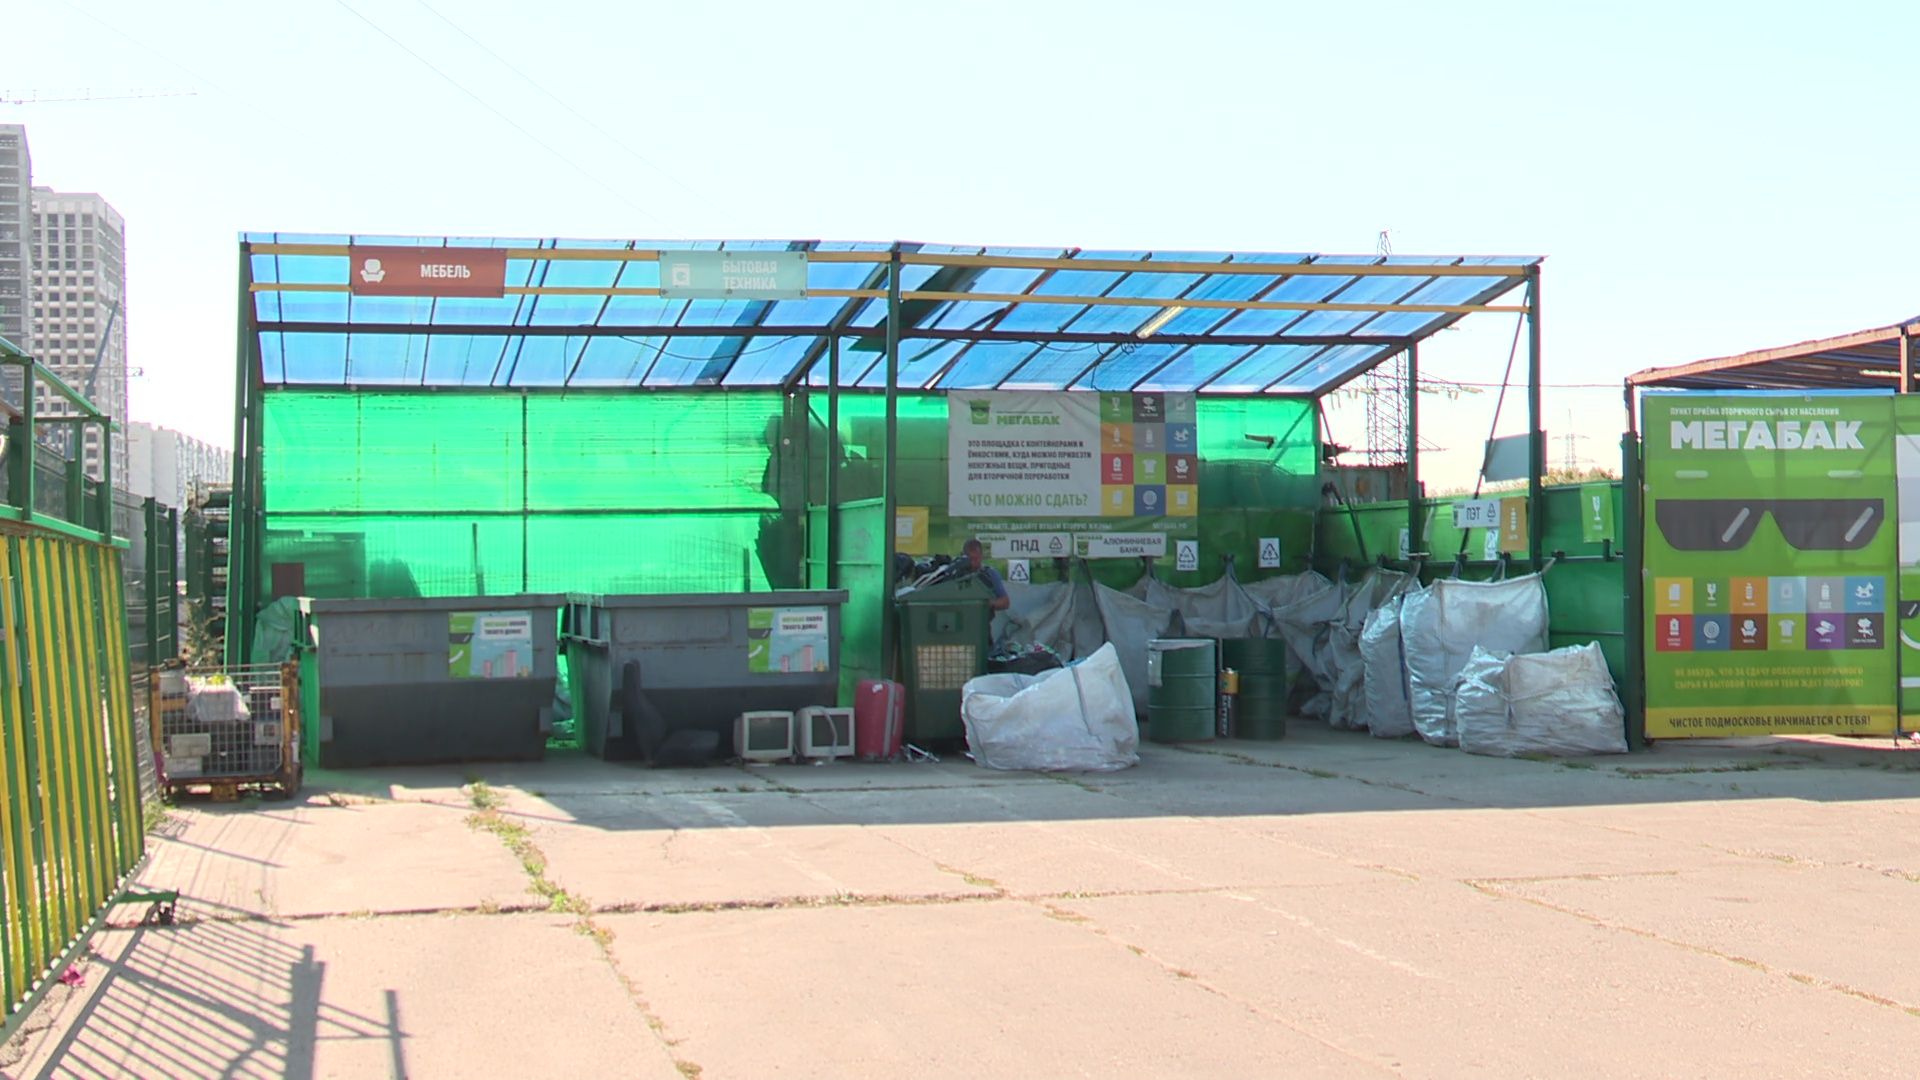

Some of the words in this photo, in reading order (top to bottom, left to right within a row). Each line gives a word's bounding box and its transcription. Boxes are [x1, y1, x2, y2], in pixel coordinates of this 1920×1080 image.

[420, 264, 471, 279] МЕБЕЛЬ
[722, 260, 777, 274] БЫТОВАЯ
[723, 276, 777, 290] ТЕХНИКА
[1670, 407, 1692, 416] ПУНКТ
[1693, 405, 1720, 416] ПРИЁМА
[1720, 407, 1764, 416] ВТОРИЧНОГО
[1765, 407, 1788, 416] СЫРЬЯ
[1789, 407, 1798, 416] ОТ
[1799, 407, 1839, 416] НАСЕЛЕНИЯ
[996, 415, 1060, 426] МЕГАБАК
[1670, 420, 1865, 450] МЕГАБАК
[968, 439, 980, 448] ЭТО
[981, 439, 1019, 448] ПЛОЩАДКА
[1020, 439, 1025, 448] С
[1026, 439, 1077, 448] КОНТЕЙНЕРАМИ
[1078, 439, 1083, 448] И
[1012, 450, 1031, 459] КУДА
[1031, 450, 1057, 459] МОЖНО
[968, 461, 1006, 470] НЕНУЖНЫЕ
[1030, 461, 1071, 470] ПРИГОДНЫЕ
[968, 472, 982, 481] ДЛЯ
[983, 472, 1022, 481] ВТОРИЧНОЙ
[1024, 472, 1070, 481] ПЕРЕРАБОТКИ
[968, 493, 992, 507] ЧТО
[995, 493, 1042, 507] МОЖНО
[1045, 493, 1088, 508] СДАТЬ?
[1010, 539, 1040, 553] ПНД
[1103, 537, 1162, 547] АЛЮМИНИЕВАЯ
[1119, 546, 1145, 554] БАНКА
[1669, 716, 1703, 729] ЧИСТОЕ
[1705, 716, 1771, 729] ПОДМОСКОВЬЕ
[1774, 715, 1833, 728] НАЧИНАЕТСЯ
[1835, 715, 1842, 728] С
[1844, 715, 1871, 727] ТЕБЯ!
